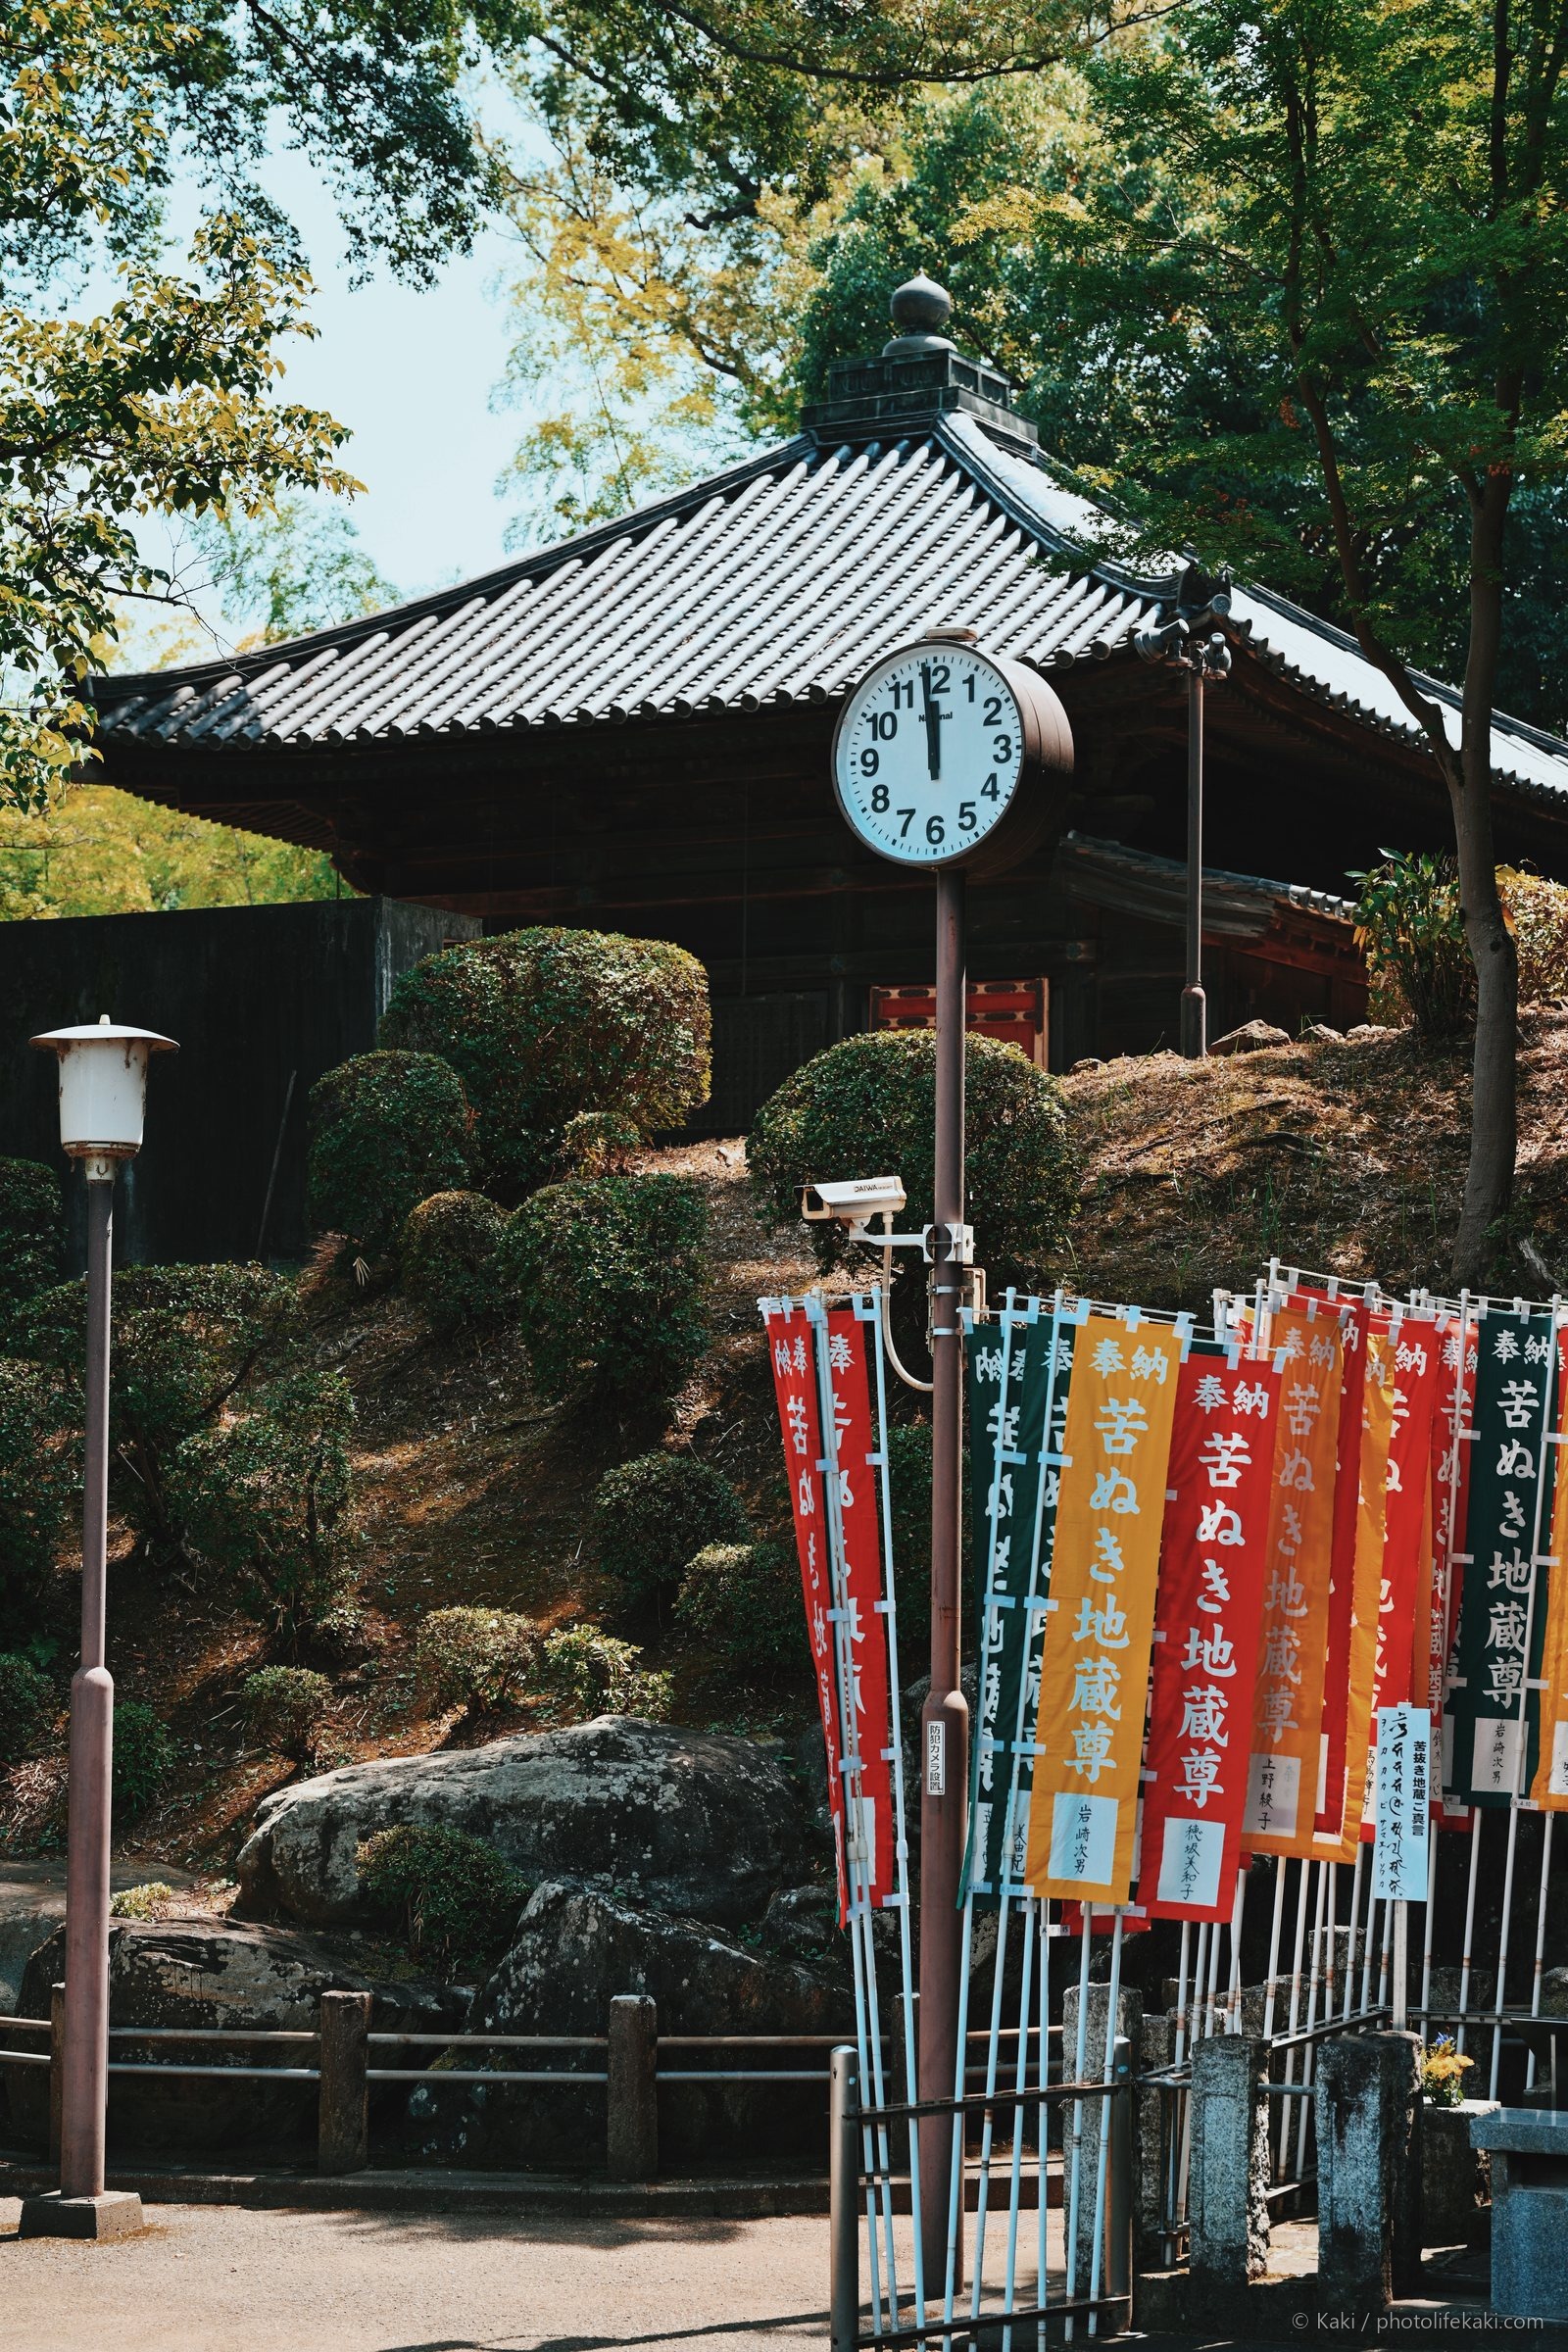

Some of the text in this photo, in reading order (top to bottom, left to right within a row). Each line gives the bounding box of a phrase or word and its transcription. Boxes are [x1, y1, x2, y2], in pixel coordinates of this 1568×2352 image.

[888, 680, 914, 710] 11
[918, 664, 951, 695] 2
[962, 674, 975, 703] 1
[866, 710, 897, 741] 10
[983, 697, 1003, 726] 2
[860, 748, 879, 777] 9
[993, 734, 1012, 763] 3
[870, 784, 890, 813] 8
[980, 773, 1000, 802] 4
[897, 808, 916, 838] 7
[925, 815, 945, 845] 6
[957, 802, 977, 831] 5
[1088, 1337, 1169, 1386] 奉納
[1282, 1326, 1336, 1372] 奉納
[1491, 1328, 1550, 1366] 奉納
[1191, 1373, 1270, 1420] 奉納
[1482, 1379, 1541, 1710] 苦ぬき地蔵尊
[1256, 1382, 1321, 1743] 苦ぬき地蔵尊
[1062, 1396, 1150, 1785] 苦ぬき地蔵尊
[1173, 1432, 1252, 1810] 苦ぬき地蔵尊
[929, 1725, 942, 1791] 防犯カメラ設置
[1411, 1740, 1426, 1837] 苦抜き地蔵ご真言
